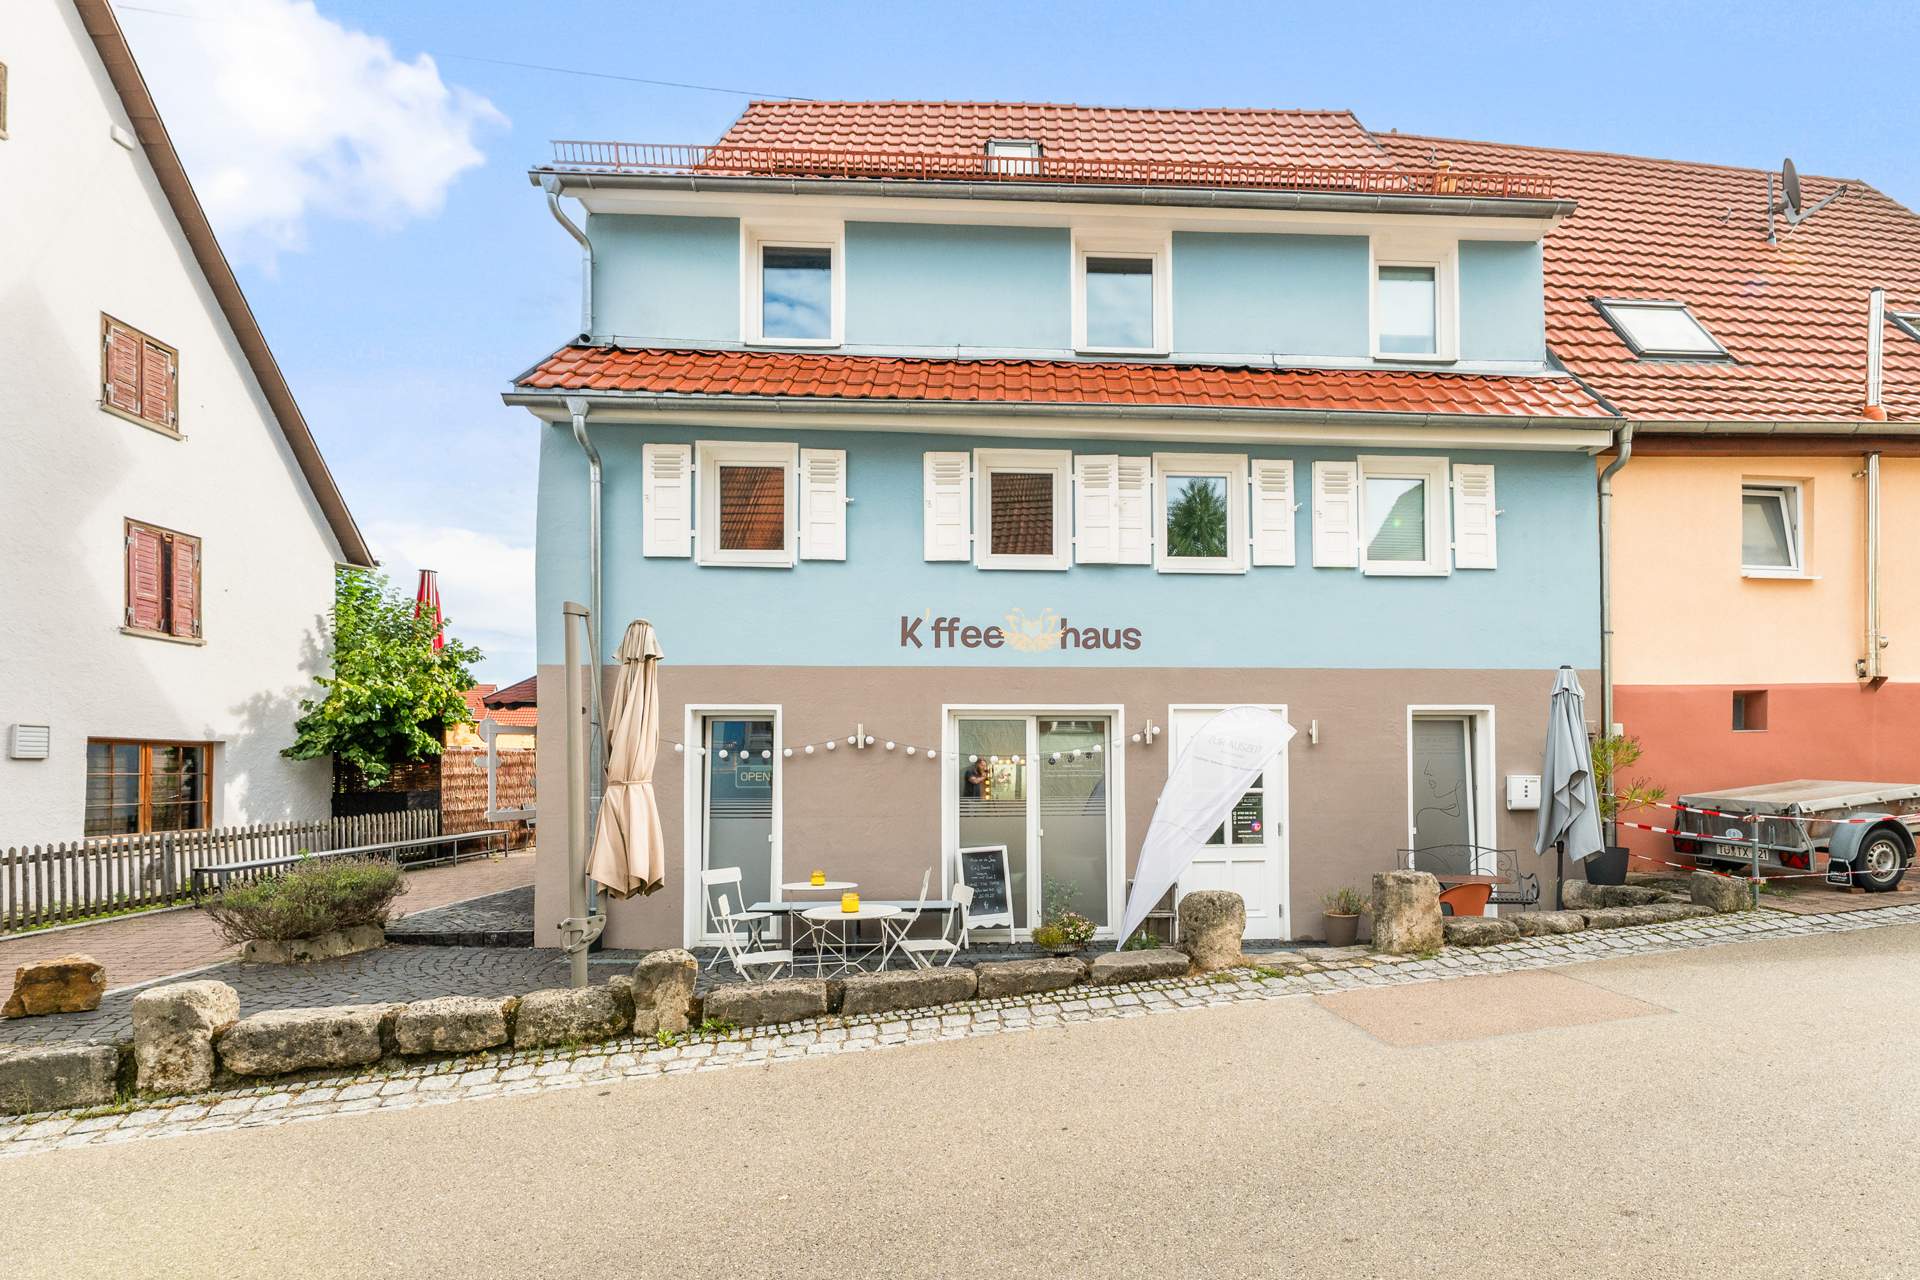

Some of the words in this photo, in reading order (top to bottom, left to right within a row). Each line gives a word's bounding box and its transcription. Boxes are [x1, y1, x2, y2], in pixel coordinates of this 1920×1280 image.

[1060, 617, 1142, 650] haus
[740, 771, 771, 782] OPEN
[1737, 847, 1749, 857] TX
